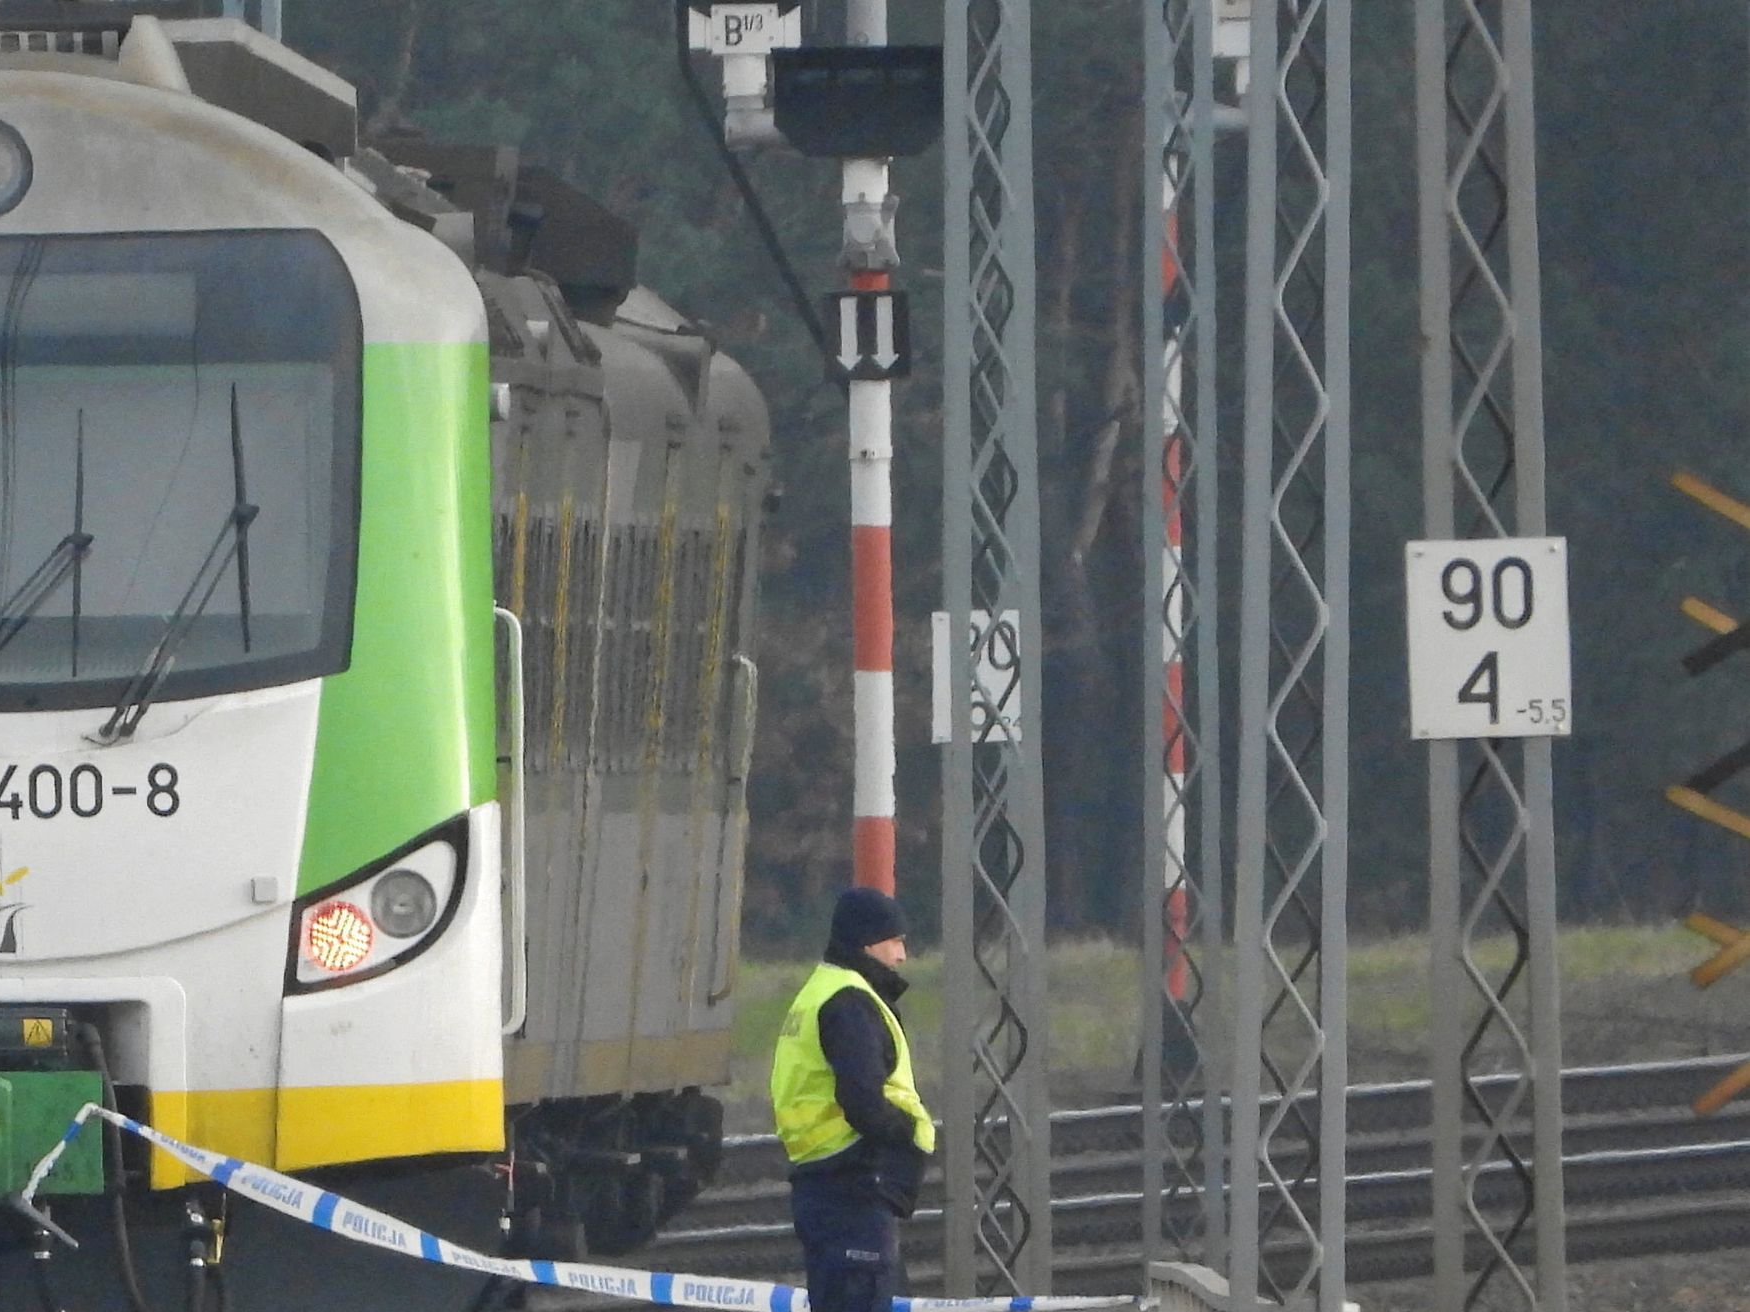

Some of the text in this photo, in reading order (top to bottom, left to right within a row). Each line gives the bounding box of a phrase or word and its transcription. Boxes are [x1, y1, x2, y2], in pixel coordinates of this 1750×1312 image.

[1441, 556, 1534, 631] 90
[1458, 651, 1499, 725] 4
[342, 1210, 408, 1249] POLICJA
[568, 1271, 638, 1297] POLICJA
[683, 1282, 756, 1306] POLICJA
